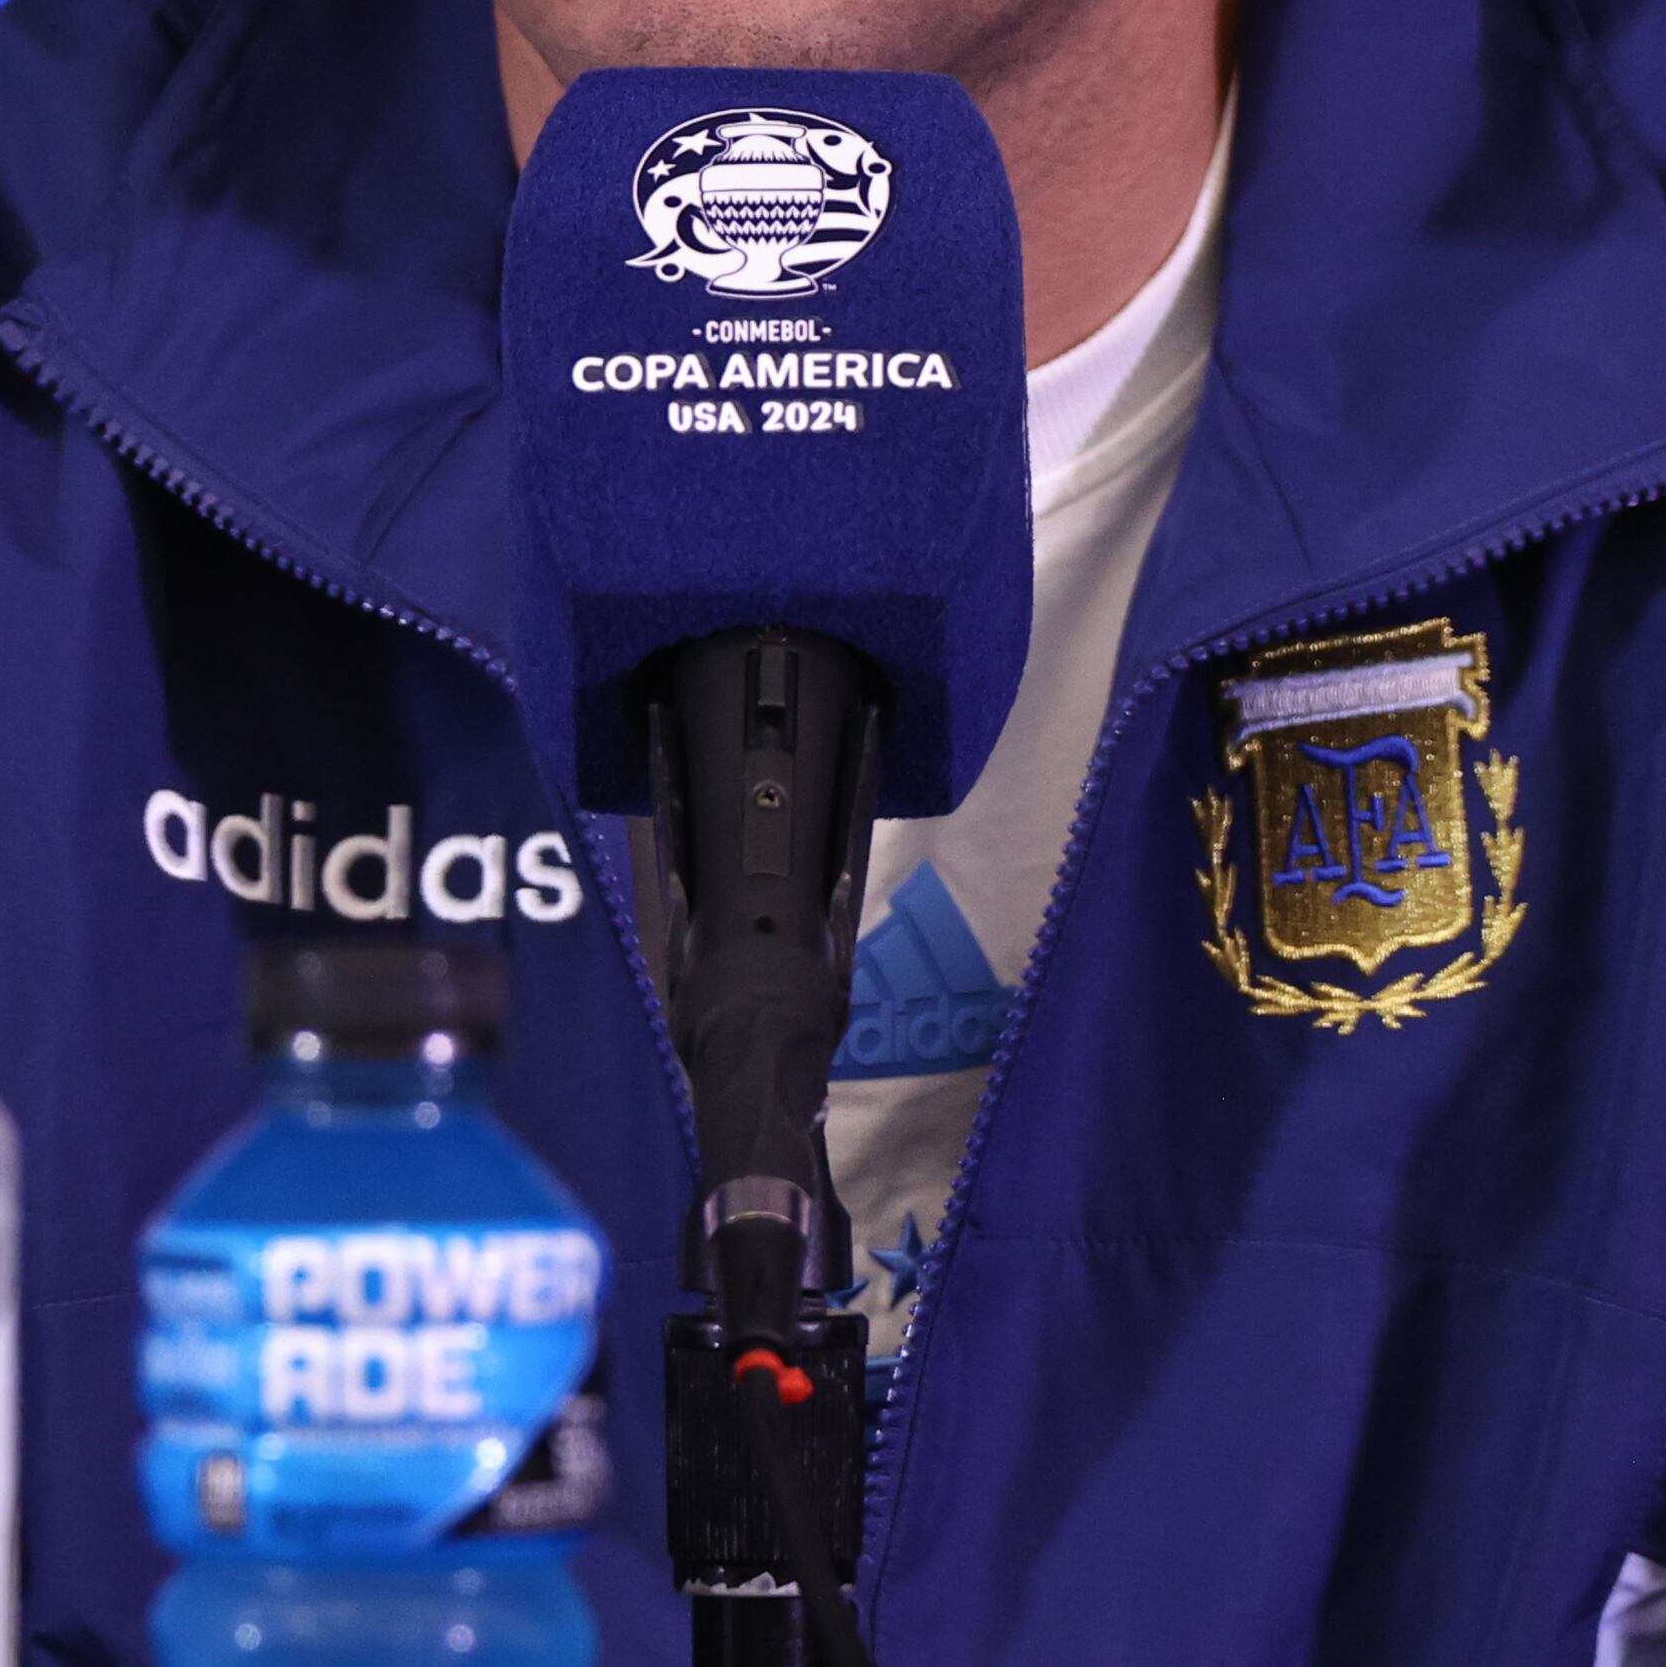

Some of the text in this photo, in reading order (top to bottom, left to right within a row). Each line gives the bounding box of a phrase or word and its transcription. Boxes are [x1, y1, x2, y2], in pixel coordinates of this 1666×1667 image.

[572, 352, 953, 391] COPA AMERICA
[668, 401, 858, 433] USA 2024
[144, 789, 584, 922] adidas
[832, 992, 1013, 1067] dida
